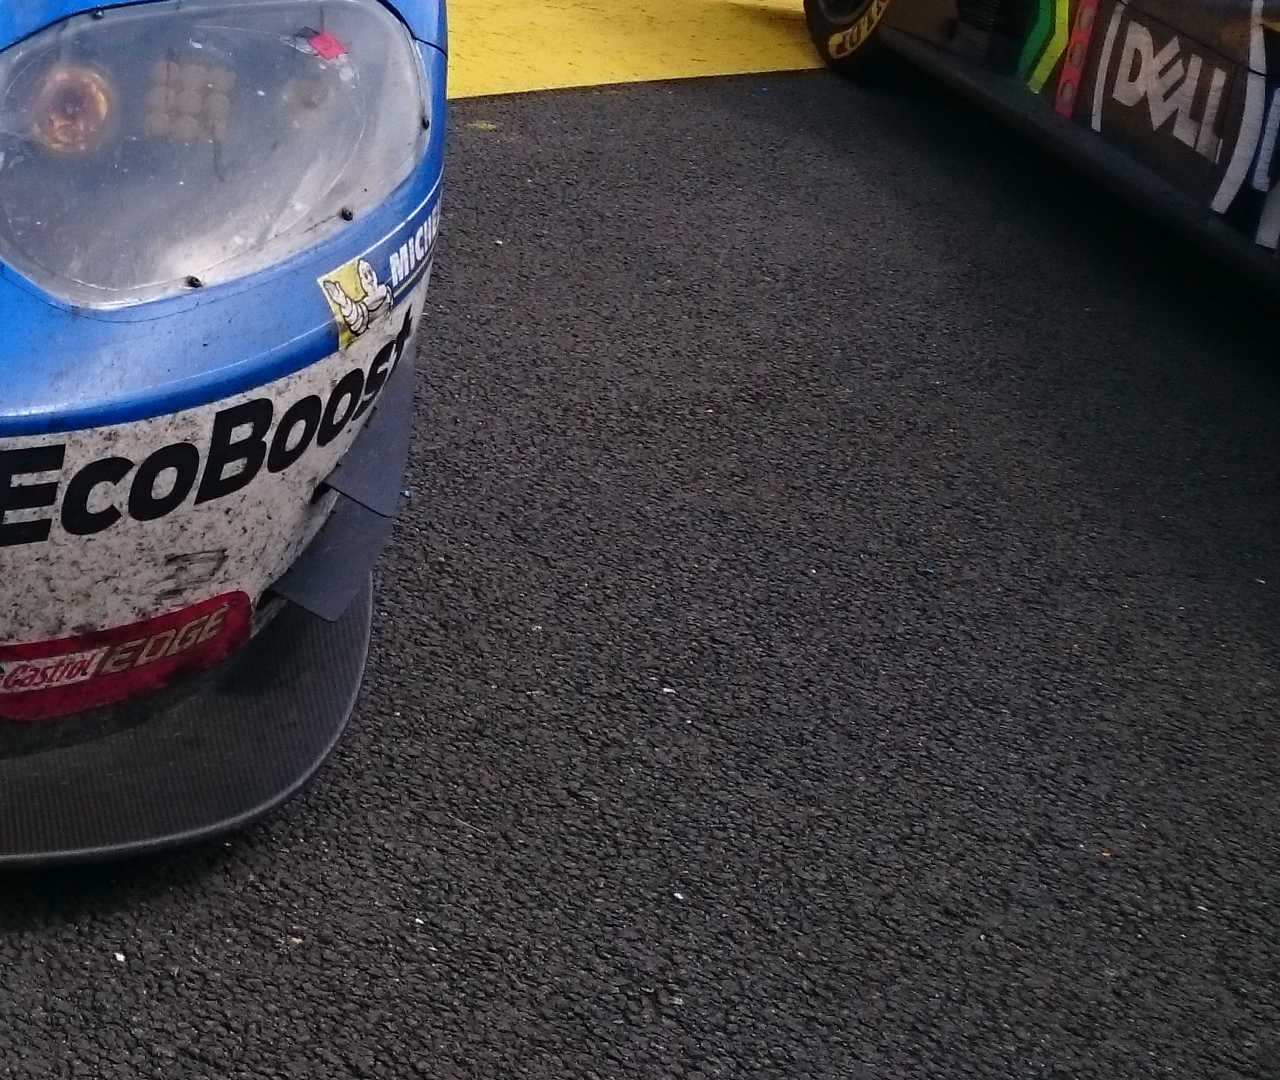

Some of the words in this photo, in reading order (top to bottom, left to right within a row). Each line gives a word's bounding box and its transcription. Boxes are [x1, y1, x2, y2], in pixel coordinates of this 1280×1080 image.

[1112, 20, 1227, 165] DELL
[0, 654, 97, 691] Castrol
[101, 605, 230, 675] EDGE
